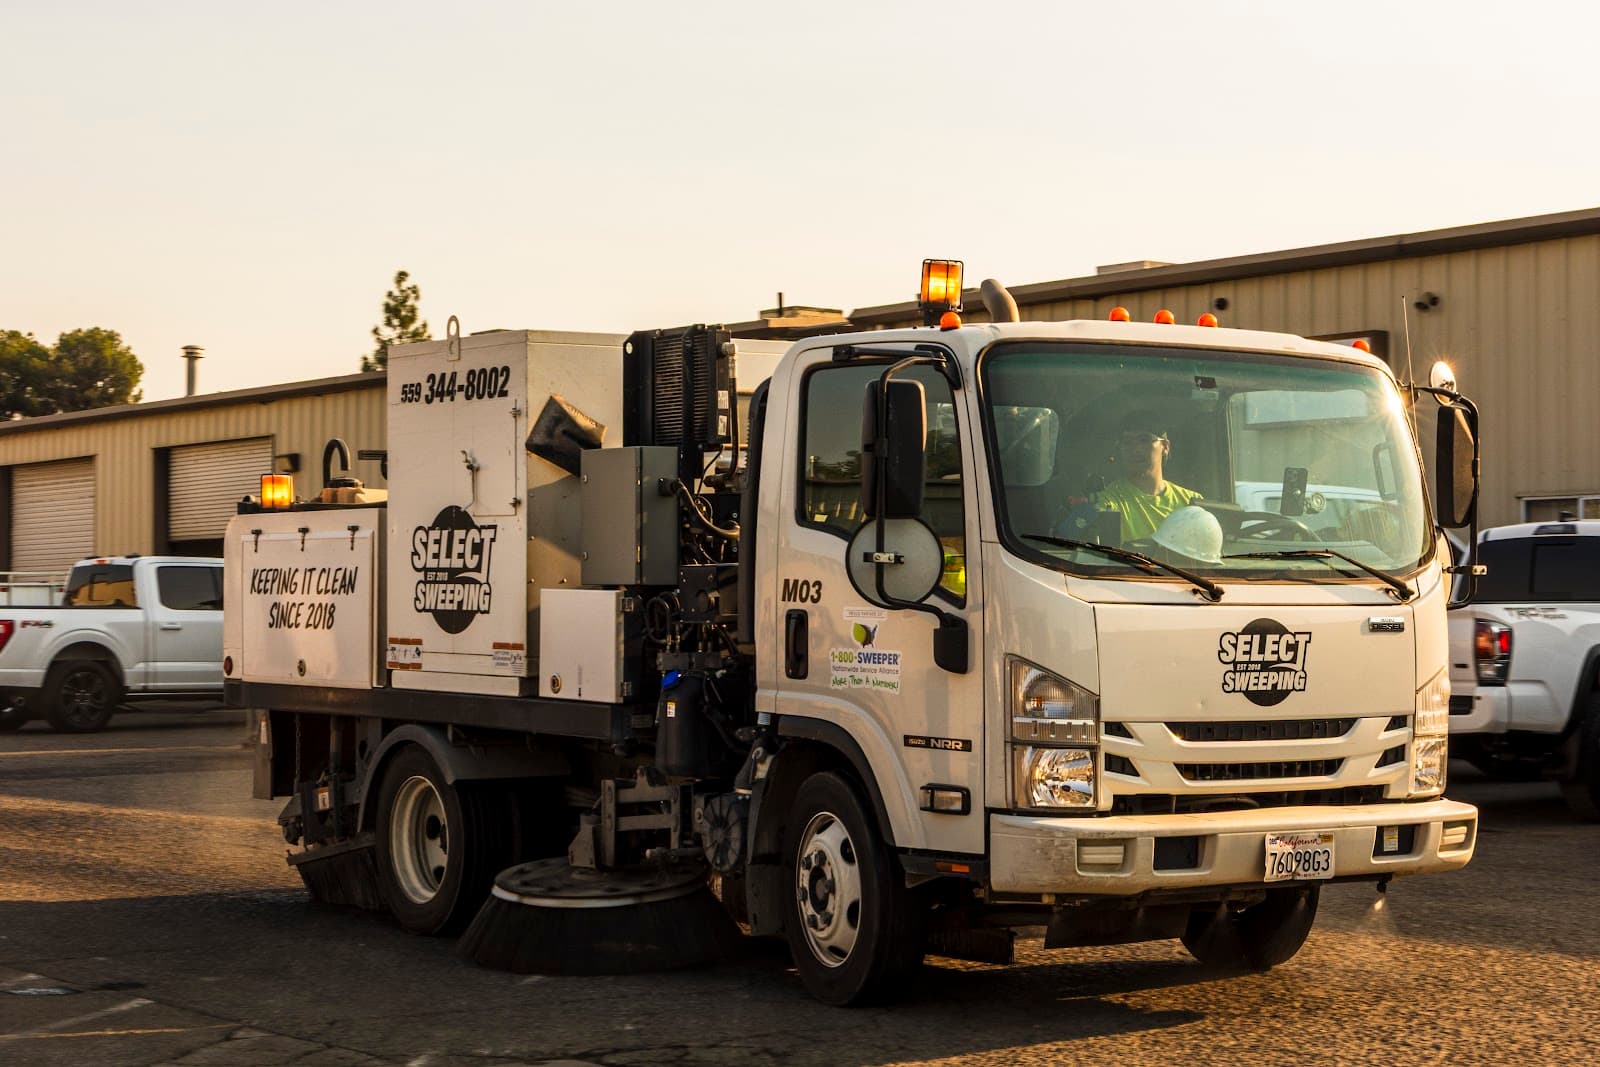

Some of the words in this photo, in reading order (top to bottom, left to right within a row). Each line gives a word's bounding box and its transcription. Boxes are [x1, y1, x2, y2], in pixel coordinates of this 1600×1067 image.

[400, 382, 422, 403] 559
[424, 365, 511, 404] 344-8002
[411, 525, 498, 582] SELECT
[250, 567, 299, 595] KEEPING
[301, 567, 317, 595] IT
[316, 566, 359, 596] CLEAN
[414, 580, 492, 614] SWEEPING
[268, 601, 305, 629] SINCE
[305, 602, 337, 630] 2018
[1218, 631, 1312, 672] SELECT
[1222, 670, 1308, 693] SWEEPING
[930, 738, 963, 750] NRR
[1277, 835, 1320, 849] California
[1270, 849, 1330, 875] 76098G3
